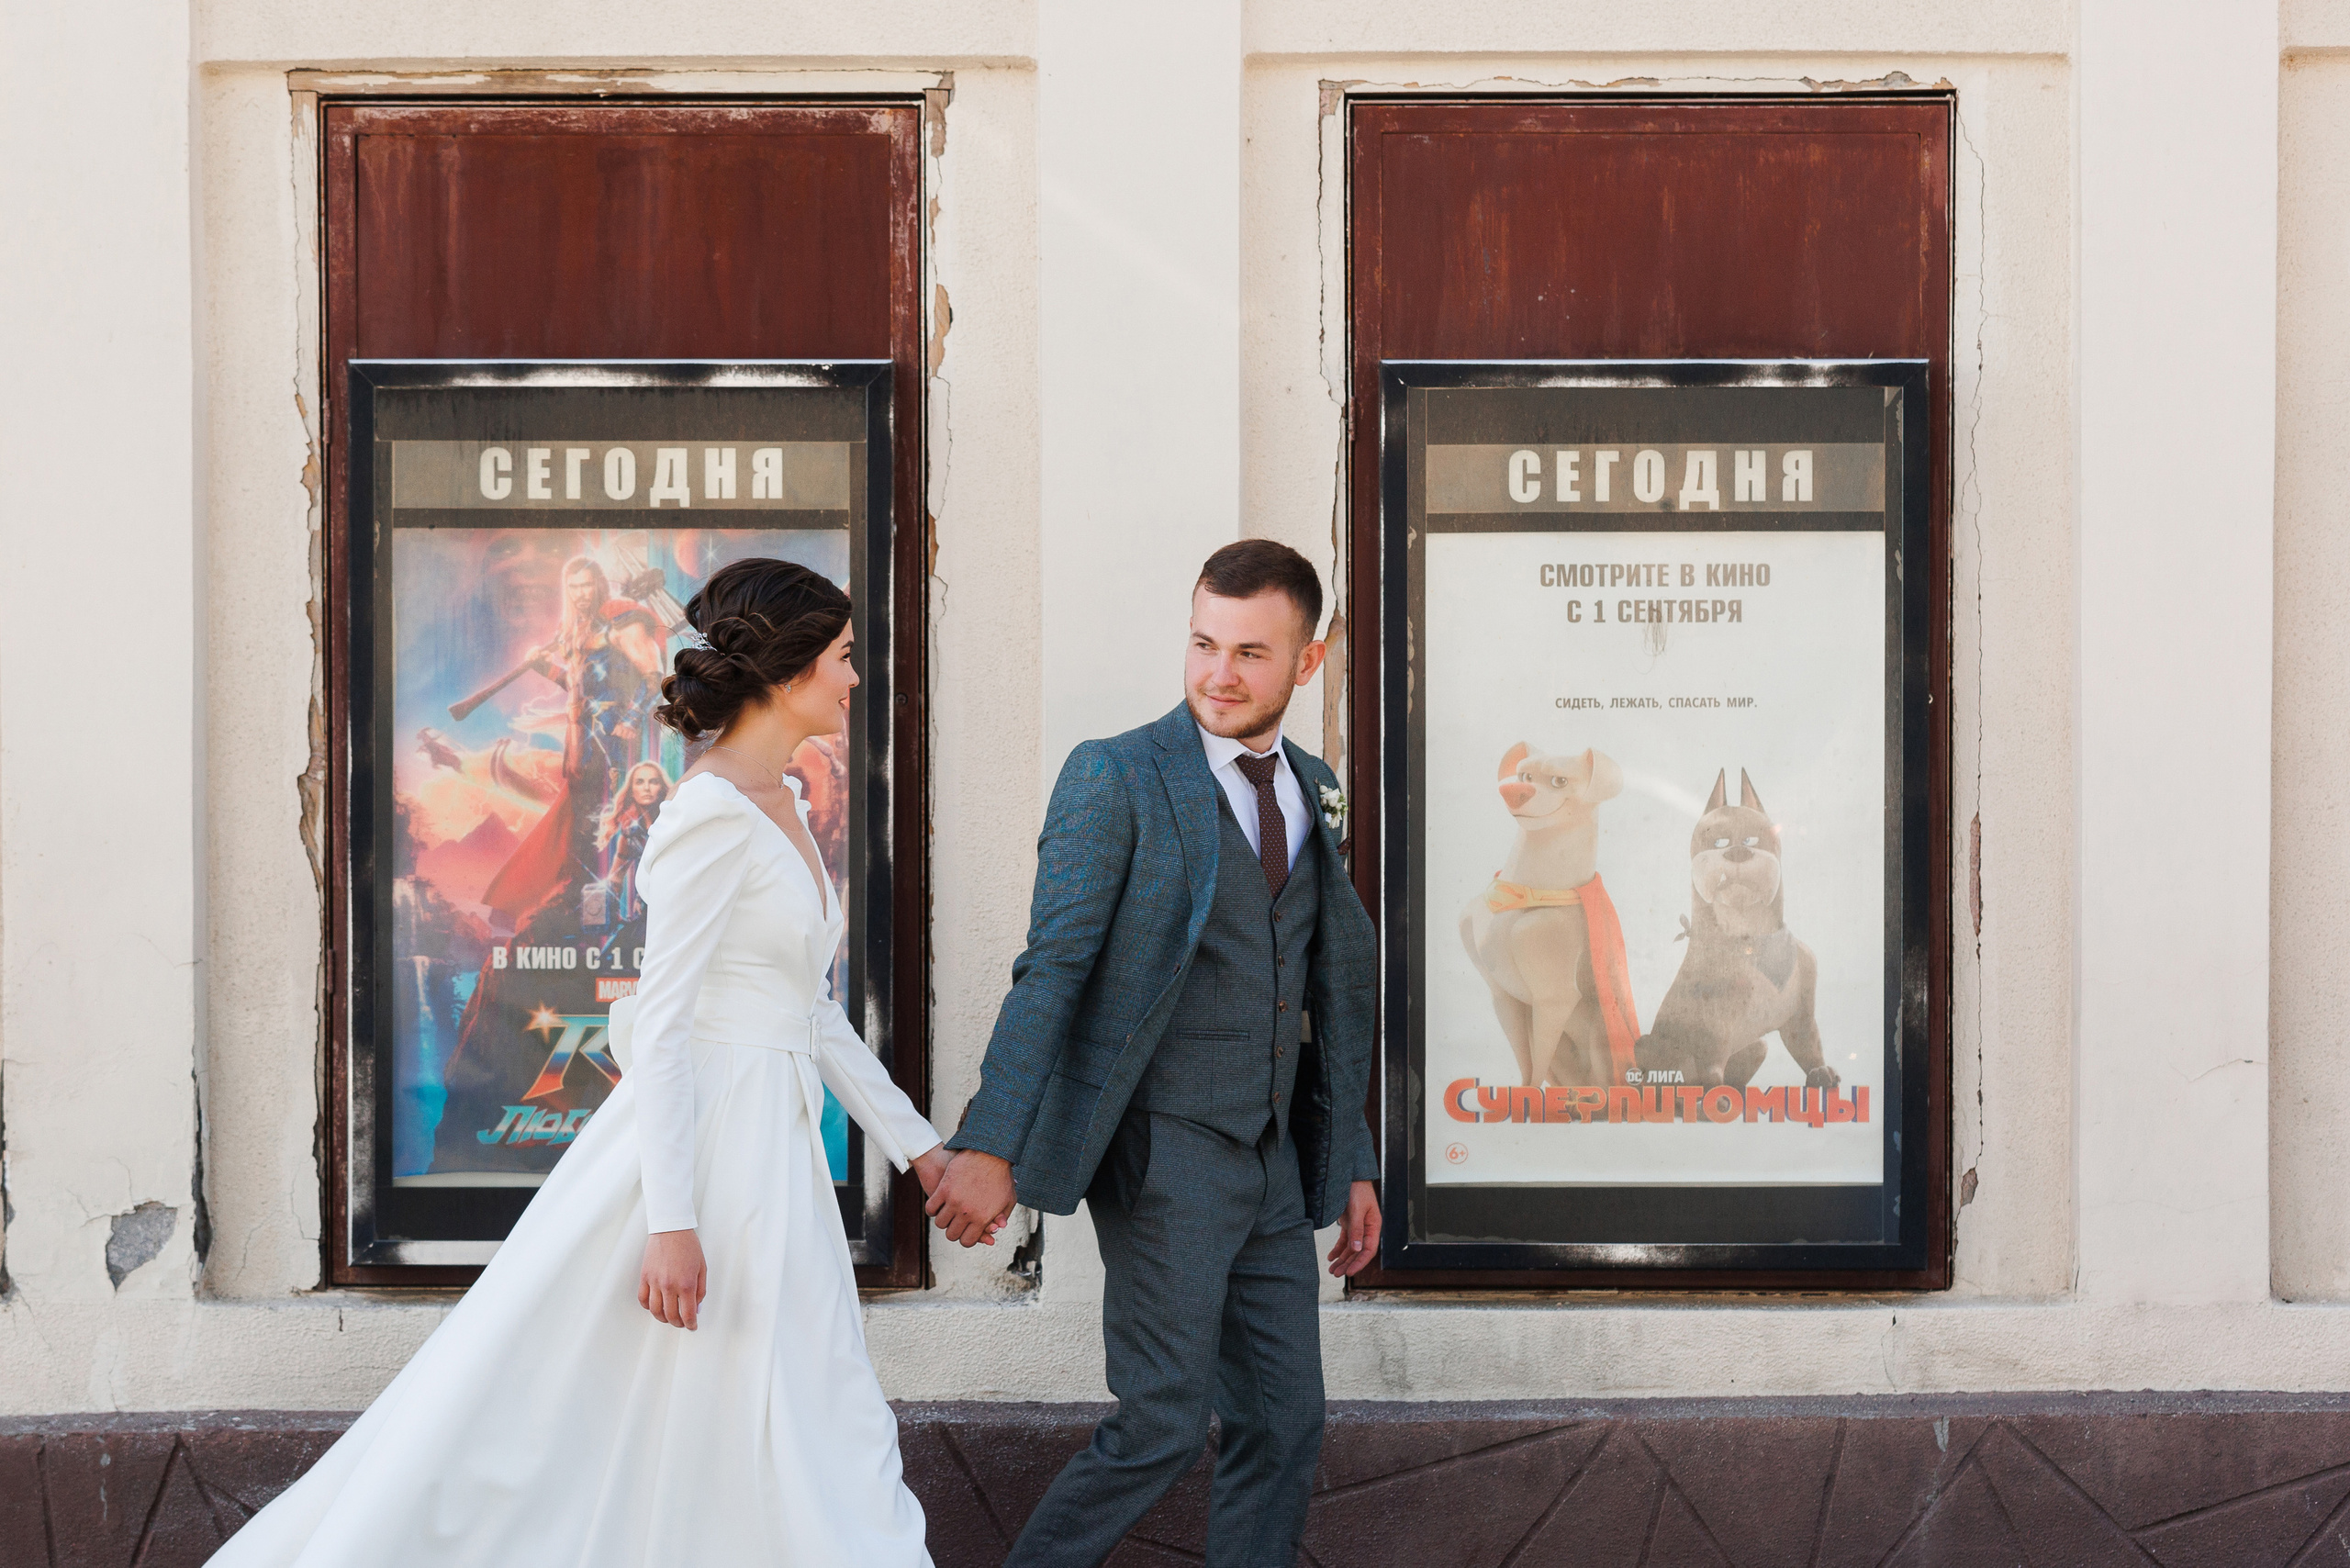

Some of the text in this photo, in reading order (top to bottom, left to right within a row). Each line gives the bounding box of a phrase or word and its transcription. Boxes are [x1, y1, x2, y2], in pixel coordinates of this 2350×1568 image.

[479, 446, 784, 509] СЕГОДНЯ
[1507, 449, 1815, 510] СЕГОДНЯ
[1539, 563, 1772, 588] СМОТРИТЕ В КИНО
[1566, 599, 1743, 623] С 1 СЕНТЯБРЯ
[1555, 697, 1758, 711] СИДЕТЬ, ЛЕЖАТЬ, СПАСАТЬ МИР.
[492, 946, 508, 969] В
[516, 946, 576, 969] КИНО
[586, 946, 601, 970] С
[610, 946, 623, 970] 1
[598, 980, 638, 1000] MARV
[1626, 1070, 1685, 1084] DC ЛИГА
[476, 1105, 592, 1146] ЛЮБ
[1447, 1145, 1467, 1161] 6+
